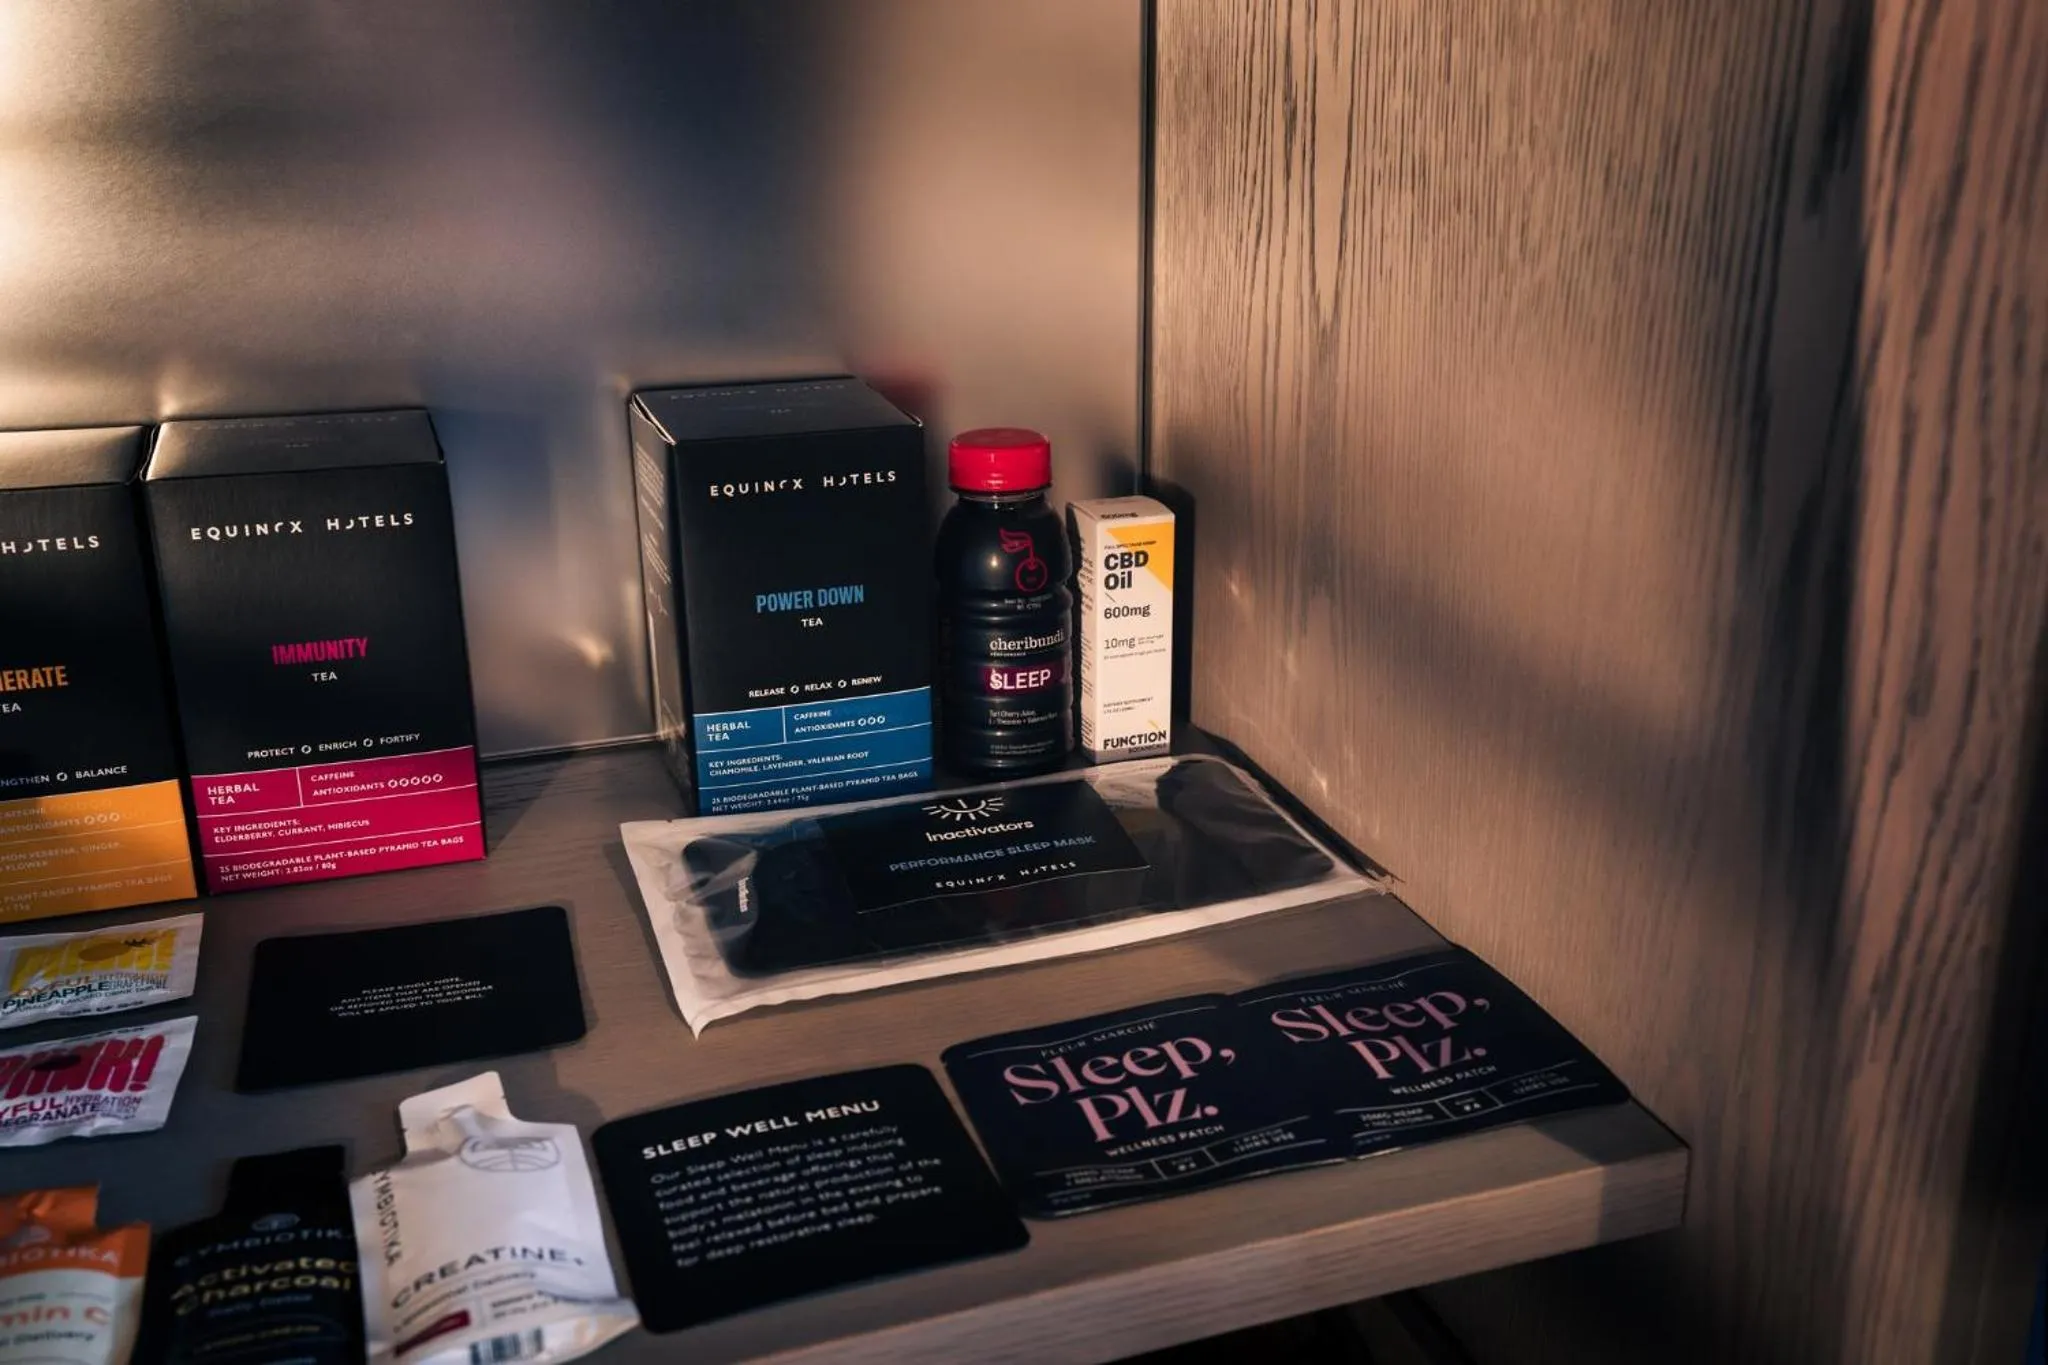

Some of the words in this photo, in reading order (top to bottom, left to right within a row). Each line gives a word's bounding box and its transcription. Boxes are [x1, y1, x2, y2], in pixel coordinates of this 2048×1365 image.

[1104, 551, 1149, 571] CBD
[1104, 571, 1132, 590] Oil
[756, 590, 814, 613] POWER
[818, 584, 864, 608] DOWN
[801, 618, 823, 628] TEA
[1104, 605, 1151, 619] 600mg
[272, 637, 369, 665] IMMUNITY
[989, 629, 1064, 651] cheribundi
[1104, 636, 1136, 649] 10mg
[312, 671, 338, 682] TEA
[749, 687, 785, 698] RELEASE
[805, 681, 833, 692] RELAX
[851, 675, 882, 686] RENEW
[989, 669, 1051, 690] SLEEP
[0, 702, 22, 713] EA
[794, 710, 832, 720] CAFFEINE
[707, 721, 751, 733] HERBAL
[707, 733, 730, 741] TEA
[794, 720, 855, 734] ANTIOXIDANTS
[247, 746, 295, 759] PROTECT
[318, 740, 357, 752] ENRICH
[379, 733, 421, 745] FORTIFY
[1103, 730, 1167, 750] FUNCTION
[709, 759, 725, 768] KEY
[807, 754, 846, 766] VALERIAN
[847, 751, 869, 761] ROOT
[76, 765, 128, 779] BALANCE
[310, 771, 355, 782] CAFFEINE
[207, 783, 260, 796] HERBAL
[312, 782, 385, 797] ANTIOXIDANTS
[723, 789, 789, 803] BIODEGRADABLE
[791, 781, 844, 795] PLANT-BASED
[846, 775, 880, 787] PYRAMID
[881, 774, 896, 783] TEA
[898, 771, 918, 780] BAGS
[209, 795, 235, 805] TEA
[712, 804, 728, 812] NET
[213, 825, 232, 834] KEY
[234, 819, 300, 832] INGREDIENTS:
[214, 831, 276, 844] ELDERBERRY,
[278, 825, 326, 838] CURRANT,
[327, 819, 370, 831] HIBISCUS
[925, 818, 1035, 843] Inactivators
[232, 856, 312, 872] BIODEGRADABLE
[313, 847, 376, 862] PLANT-BASED
[378, 842, 419, 854] PYRAMID
[420, 839, 439, 849] TEA
[440, 836, 464, 845] BAGS
[889, 848, 1006, 873] PERFORMANCE
[1006, 841, 1051, 858] SLEEP
[1054, 833, 1096, 851] MASK
[220, 874, 241, 882] NET
[2, 981, 109, 1009] PINEAPPLE
[1270, 990, 1490, 1044] Sleep,
[1347, 1036, 1487, 1080] Plz.
[1002, 1036, 1236, 1105] Sleep,
[1391, 1076, 1455, 1096] WELLNESS
[1455, 1064, 1498, 1081] PATCH
[0, 1103, 101, 1128] EGRANATE
[1076, 1086, 1219, 1143] Plz.
[641, 1131, 717, 1161] SLEEP
[725, 1114, 799, 1140] WELL
[804, 1099, 881, 1125] MENU
[1105, 1132, 1176, 1157] WELLNESS
[1179, 1123, 1225, 1140] PATCH
[650, 1170, 680, 1185] Our
[686, 1160, 726, 1176] Sleep
[730, 1150, 764, 1165] Well
[768, 1142, 808, 1156] Menu
[812, 1138, 824, 1147] is
[842, 1125, 898, 1142] carefully
[654, 1177, 712, 1198] curated
[716, 1160, 781, 1182] selection
[786, 1155, 800, 1166] of
[806, 1148, 842, 1164] sleep
[846, 1136, 906, 1156] inducing
[658, 1194, 694, 1210] food
[700, 1188, 726, 1200] and
[731, 1172, 796, 1192] beverage
[801, 1159, 862, 1178] offerings
[866, 1152, 895, 1163] that
[662, 1203, 724, 1226] support
[728, 1194, 754, 1207] the
[758, 1182, 810, 1200] natural
[814, 1165, 894, 1189] production
[900, 1162, 914, 1172] of
[918, 1156, 942, 1168] the
[722, 1200, 797, 1224] melatonin
[800, 1196, 814, 1206] in
[818, 1188, 843, 1200] the
[848, 1177, 903, 1196] evening
[907, 1174, 923, 1184] to
[672, 1238, 701, 1252] feel
[705, 1223, 762, 1244] relaxed
[766, 1210, 817, 1228] before
[821, 1202, 849, 1216] bed
[854, 1195, 880, 1208] and
[885, 1185, 942, 1204] prepare
[676, 1255, 699, 1268] for
[705, 1244, 744, 1261] deep
[750, 1222, 832, 1248] restorative
[836, 1213, 879, 1229] sleep.
[176, 1274, 352, 1316] Charcoal
